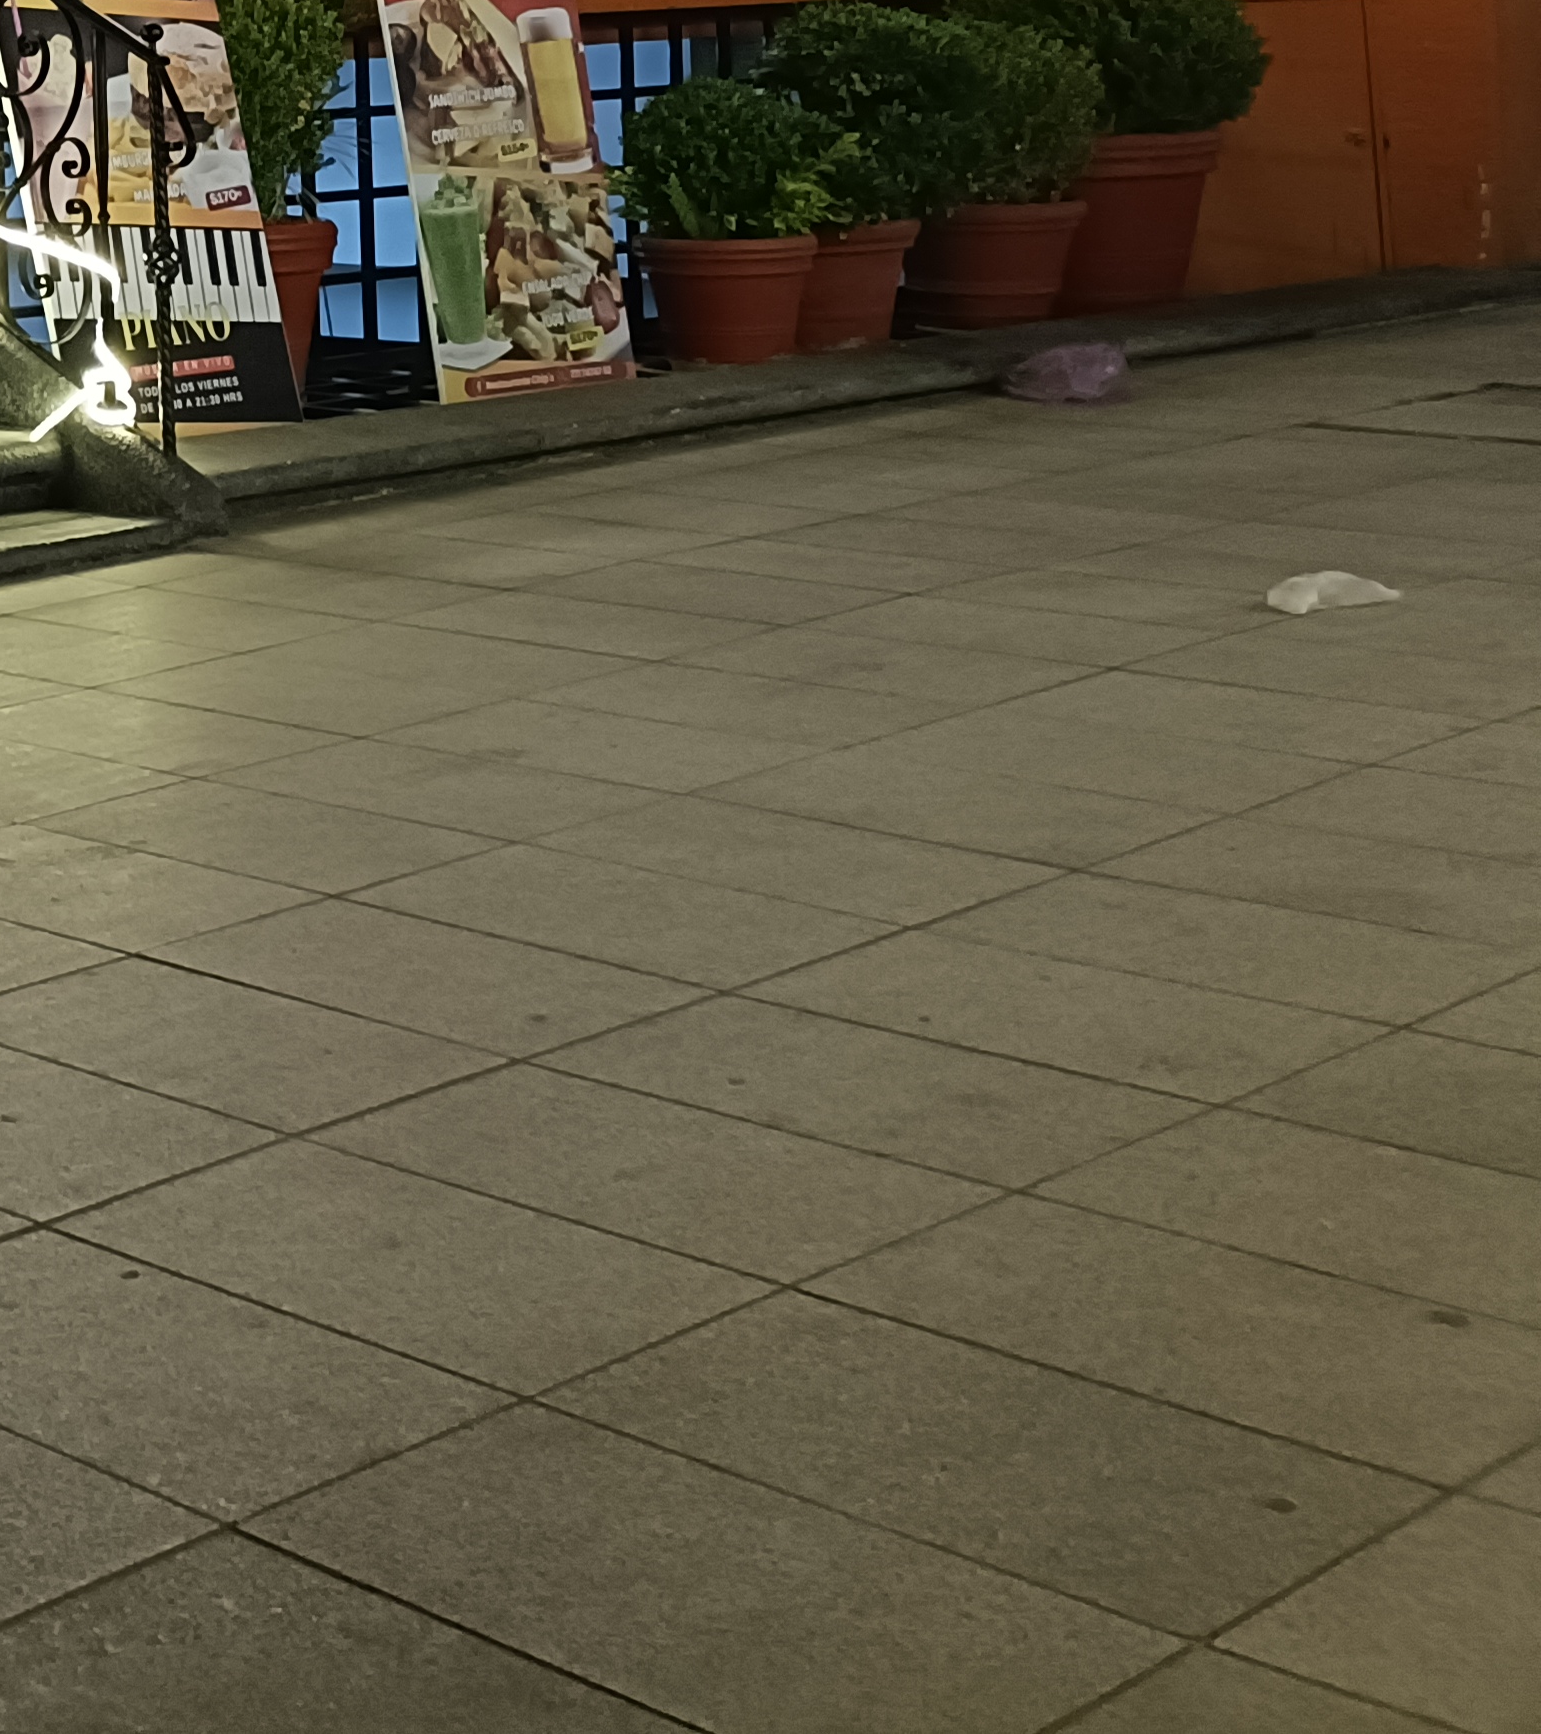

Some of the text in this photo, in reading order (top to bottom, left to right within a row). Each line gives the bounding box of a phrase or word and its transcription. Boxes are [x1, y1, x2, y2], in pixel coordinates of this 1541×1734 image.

[174, 381, 195, 394] LOS
[197, 376, 240, 391] VIERNES
[140, 402, 155, 415] DE
